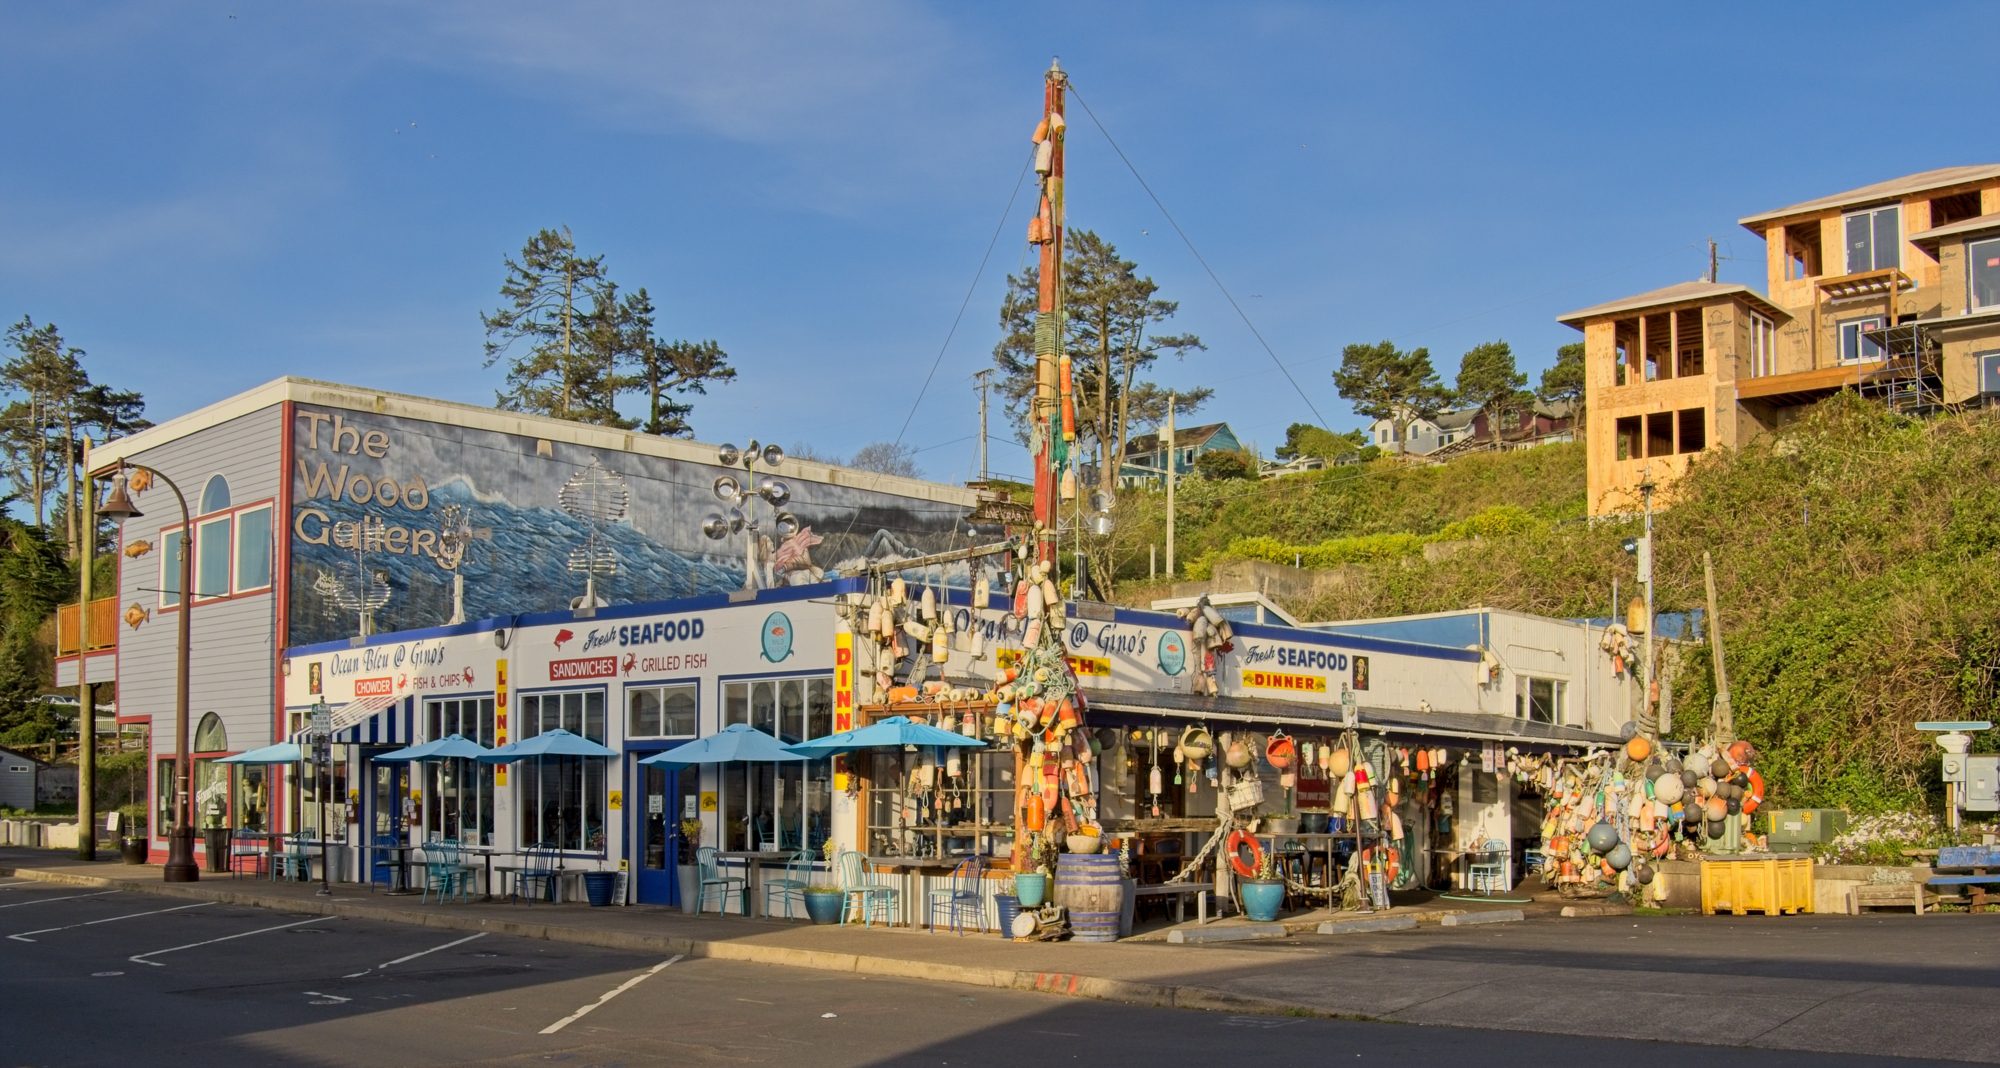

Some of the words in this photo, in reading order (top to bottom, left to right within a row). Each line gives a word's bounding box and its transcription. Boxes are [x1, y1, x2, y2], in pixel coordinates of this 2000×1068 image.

[298, 410, 390, 458] The
[298, 459, 429, 511] Wood
[295, 508, 465, 569] Gallery
[583, 625, 617, 652] Fresh
[618, 618, 704, 648] SEAFOOD
[1070, 621, 1089, 648] @
[1096, 623, 1147, 656] Gino's
[330, 653, 359, 676] Ocean
[363, 649, 389, 672] Bleu
[394, 644, 405, 668] @
[410, 640, 445, 670] Gino's
[552, 660, 614, 678] SANDWICHES
[641, 655, 681, 673] GRILLED
[684, 653, 707, 669] FISH
[1245, 645, 1275, 665] Fresh
[1277, 647, 1348, 671] SEAFOOD
[356, 680, 391, 694] CHOWDER
[412, 677, 429, 690] FISH
[430, 676, 436, 688] &
[439, 673, 461, 687] CHIPS
[1254, 673, 1315, 690] DINNER
[836, 648, 851, 774] DINNR
